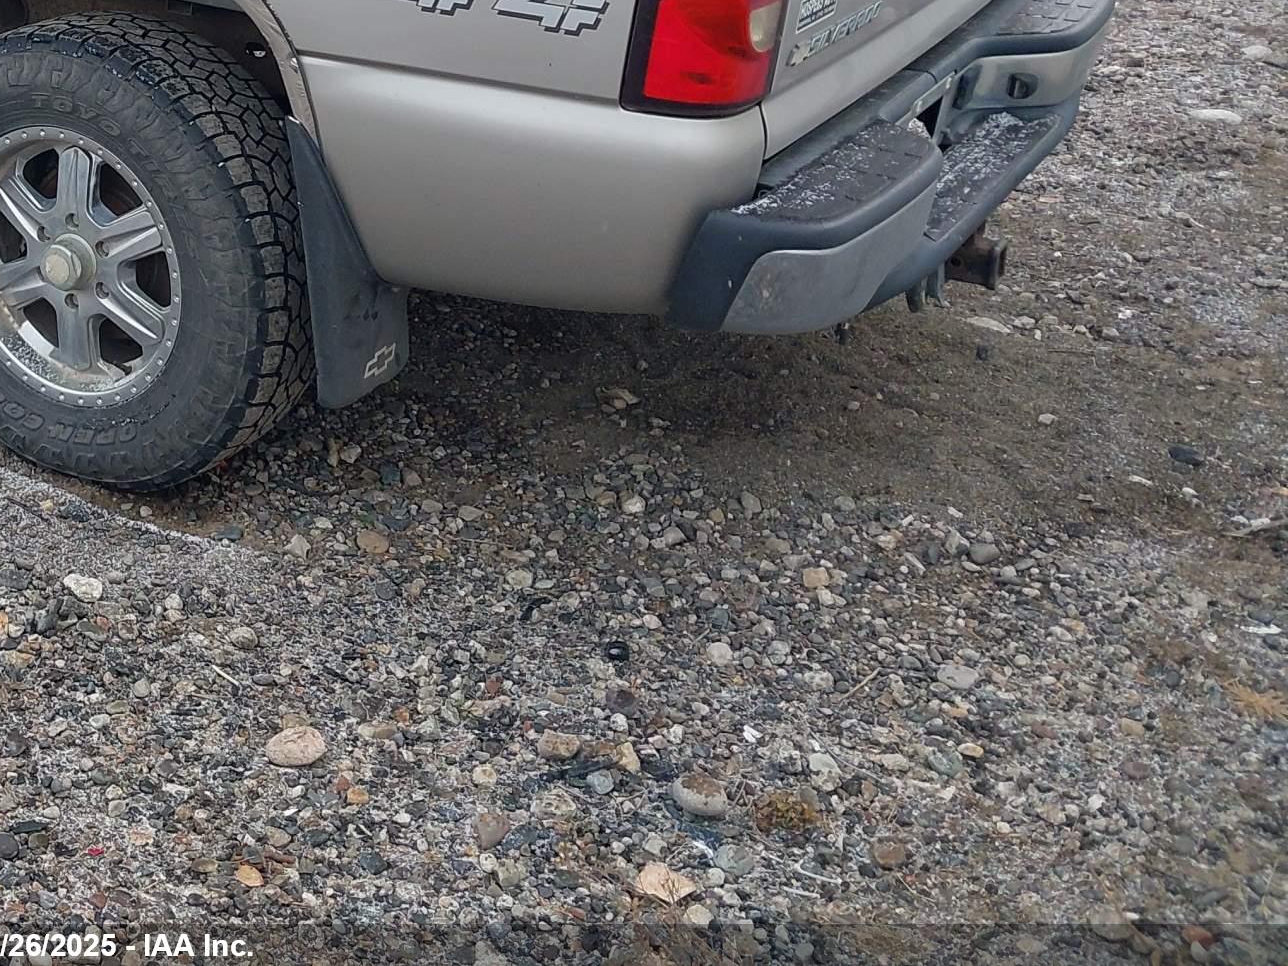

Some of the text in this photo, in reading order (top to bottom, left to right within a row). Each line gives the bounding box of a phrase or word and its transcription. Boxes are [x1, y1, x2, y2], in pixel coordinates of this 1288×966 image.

[807, 0, 884, 56] SILVERADO
[30, 93, 121, 136] TOYO
[50, 422, 138, 446] OPEN
